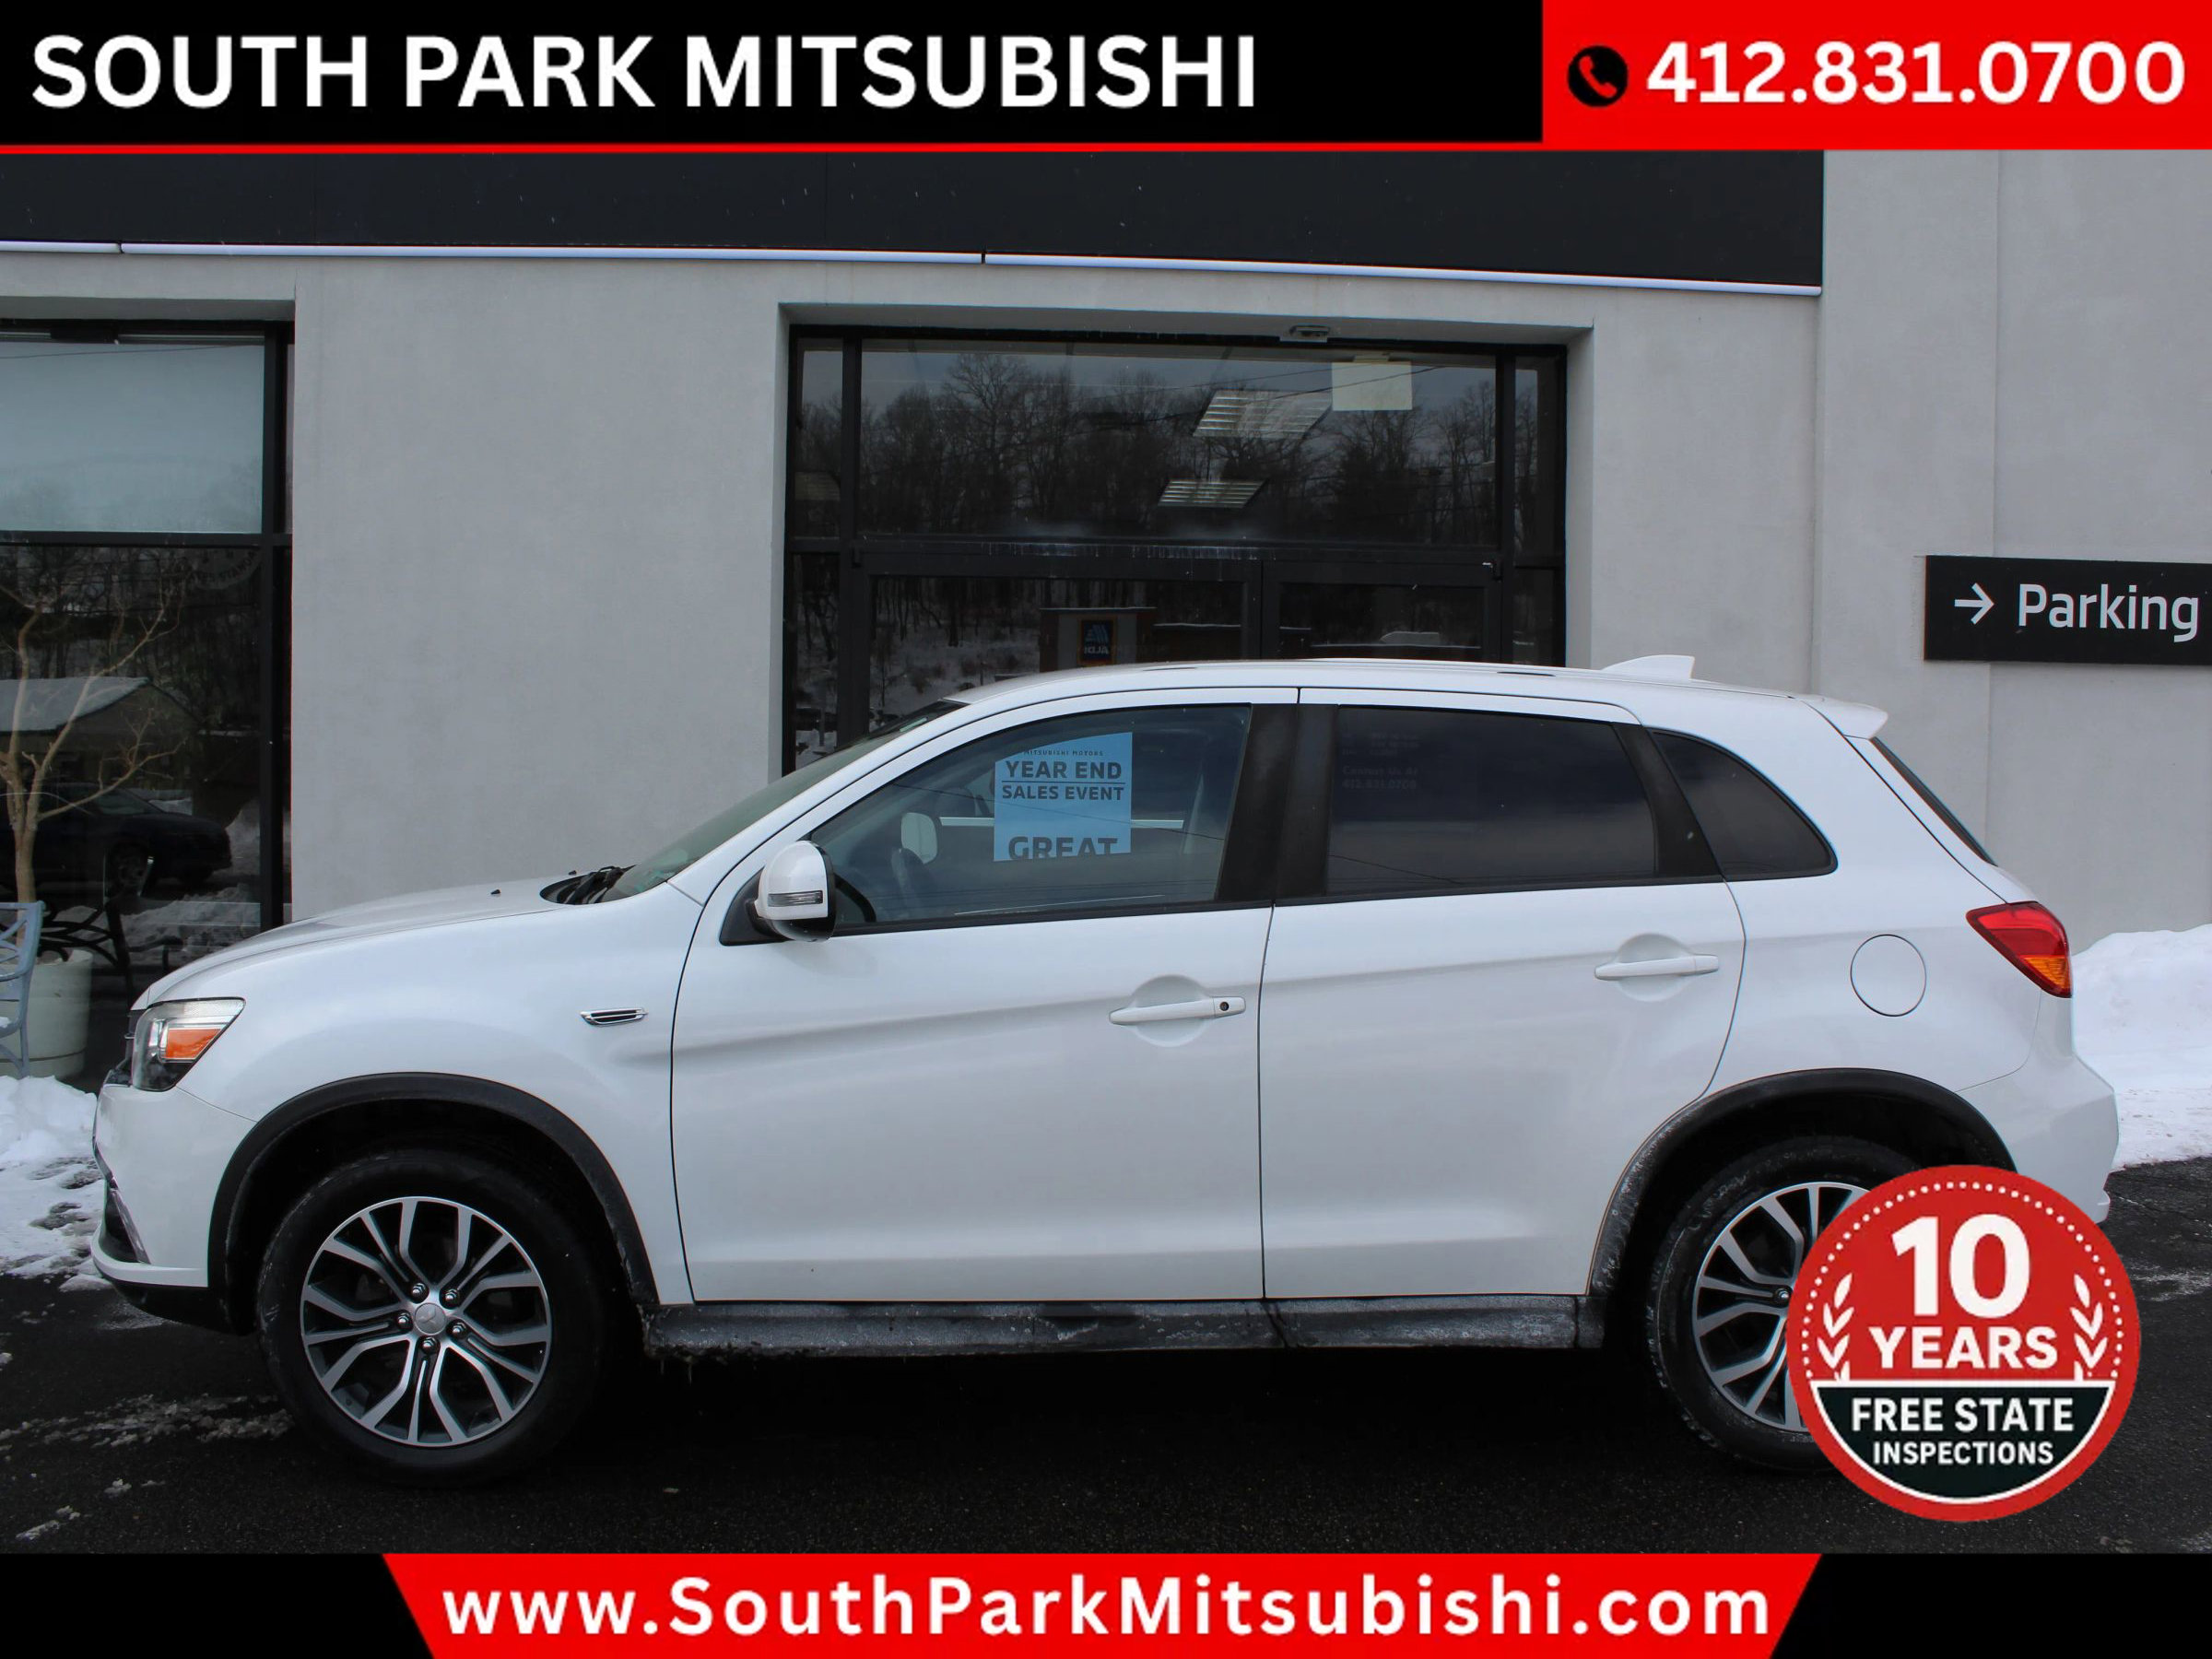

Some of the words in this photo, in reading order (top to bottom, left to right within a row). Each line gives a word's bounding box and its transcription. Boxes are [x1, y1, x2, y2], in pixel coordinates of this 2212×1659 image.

[2018, 583, 2198, 642] Parking
[1006, 760, 1067, 778] YEAR
[1075, 761, 1123, 780] END
[1002, 785, 1059, 799] SALES
[1065, 786, 1124, 801] EVENT
[1008, 836, 1118, 861] GREAT
